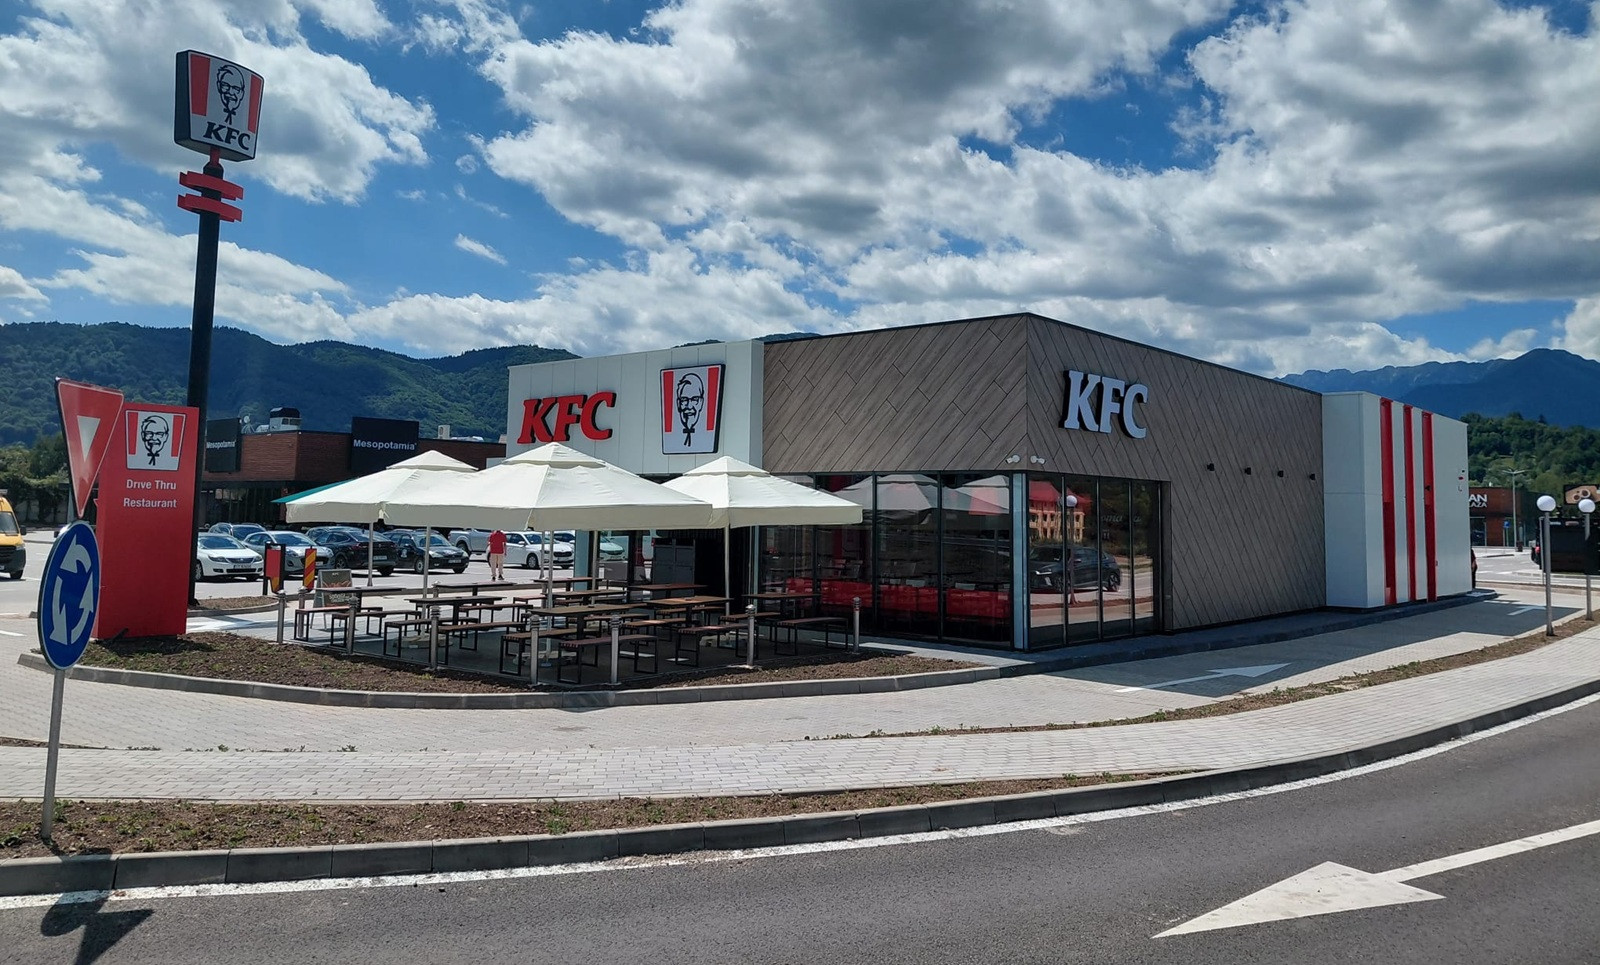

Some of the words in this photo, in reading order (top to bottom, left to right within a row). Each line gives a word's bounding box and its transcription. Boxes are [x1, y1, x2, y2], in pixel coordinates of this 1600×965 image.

[203, 121, 250, 150] KFC
[1059, 369, 1149, 439] KFC
[516, 391, 617, 444] KFC
[353, 439, 417, 451] Mesopotamia
[126, 479, 152, 489] Drive
[155, 480, 177, 490] Thru
[123, 497, 177, 508] Restaurant
[1469, 494, 1487, 502] AN
